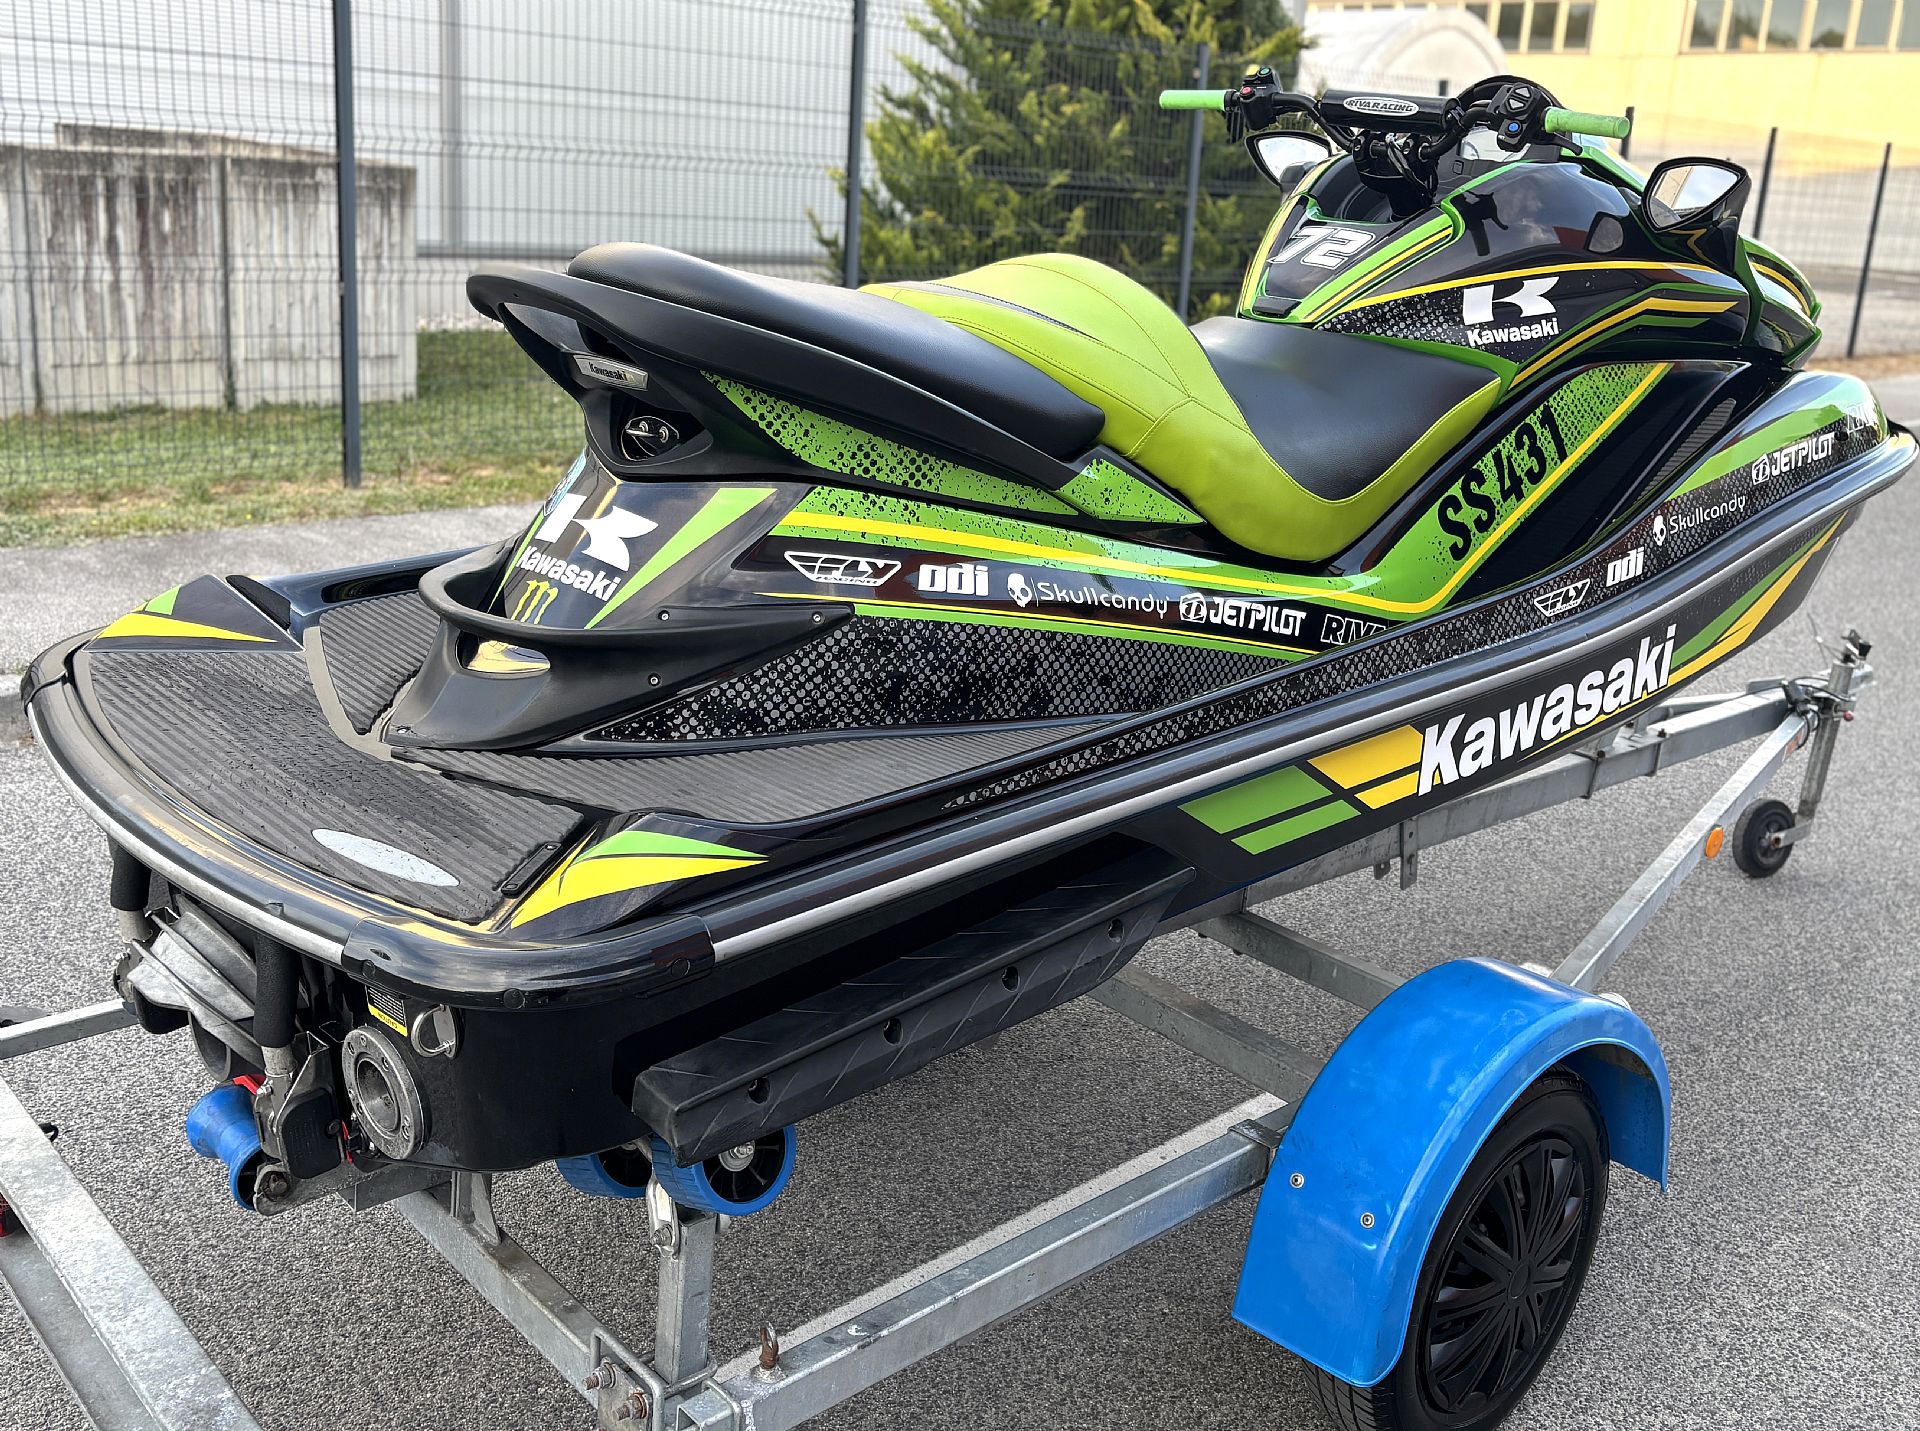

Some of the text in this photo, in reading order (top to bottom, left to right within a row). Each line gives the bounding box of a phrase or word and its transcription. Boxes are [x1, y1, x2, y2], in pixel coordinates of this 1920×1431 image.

[1266, 226, 1376, 270] 72
[1466, 317, 1560, 347] Kawasaki
[588, 361, 628, 381] Kawasaki
[1669, 493, 1746, 535] Skullcandy
[516, 545, 622, 602] Kawasaki
[1036, 581, 1170, 620] Skullcandy
[1320, 613, 1386, 646] RIV
[1418, 623, 1677, 797] Kawasaki
